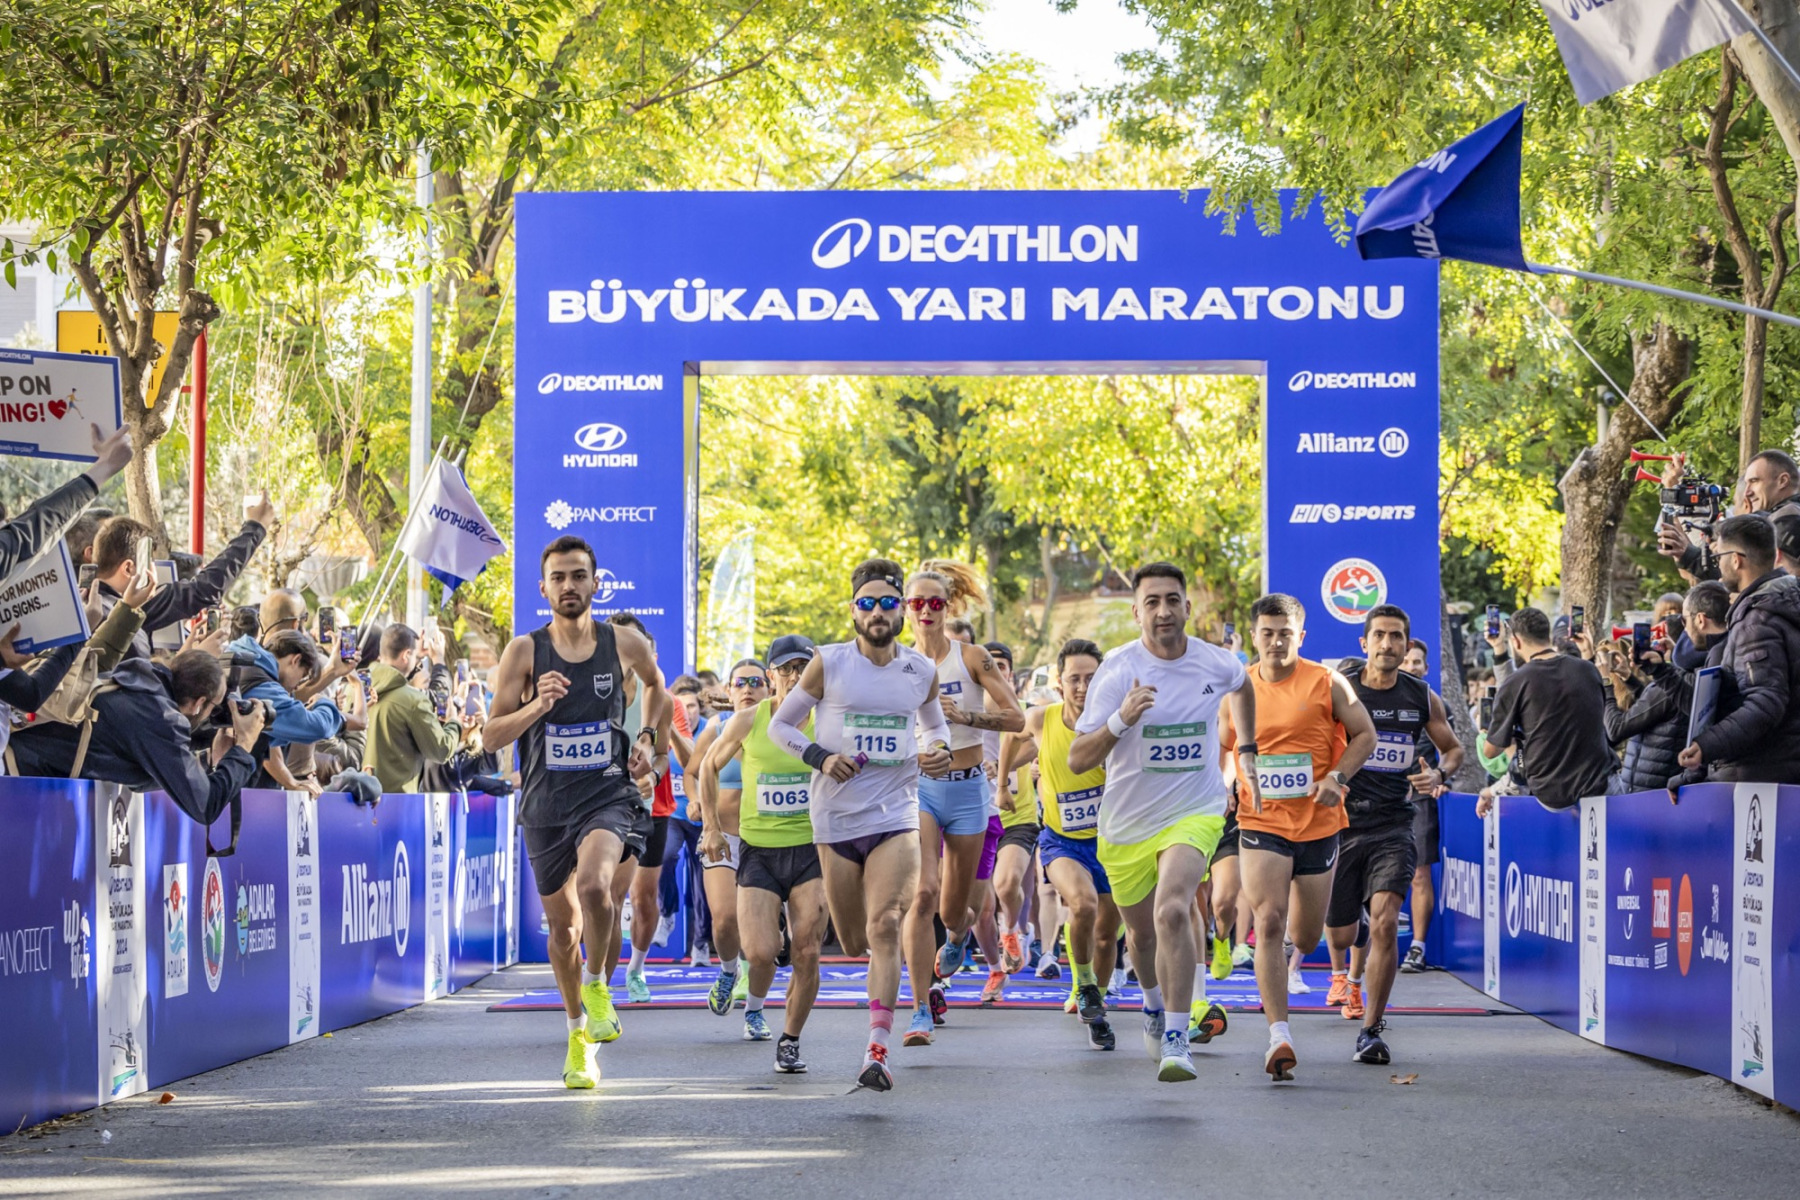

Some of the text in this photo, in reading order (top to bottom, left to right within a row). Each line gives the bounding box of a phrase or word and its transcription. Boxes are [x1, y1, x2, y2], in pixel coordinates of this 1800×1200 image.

[878, 224, 1138, 262] DECATHLON
[548, 278, 1405, 323] BÜYÜKADA YARI MARATONU
[0, 376, 52, 396] P ON
[563, 375, 663, 391] DECATHLON
[1314, 372, 1416, 389] DECATHLON
[1296, 433, 1375, 453] Allianz
[563, 454, 638, 467] HYUNDAI
[574, 507, 657, 522] PANOFFECT
[1342, 505, 1416, 520] SPORTS
[15, 569, 58, 597] MONTHS
[597, 581, 635, 590] ERSAL
[12, 596, 50, 619] SIGNS...
[552, 740, 606, 759] 5484
[854, 734, 897, 753] 1115
[1150, 742, 1202, 761] 2392
[1259, 772, 1308, 789] 2069
[762, 789, 809, 806] 1063
[1064, 801, 1101, 822] 534
[1446, 857, 1481, 920] DECATHLON
[249, 883, 276, 921] ADALAR
[341, 862, 392, 945] Allianz
[1524, 873, 1573, 943] HYUNDAI
[249, 922, 276, 953] BELEDİYESİ
